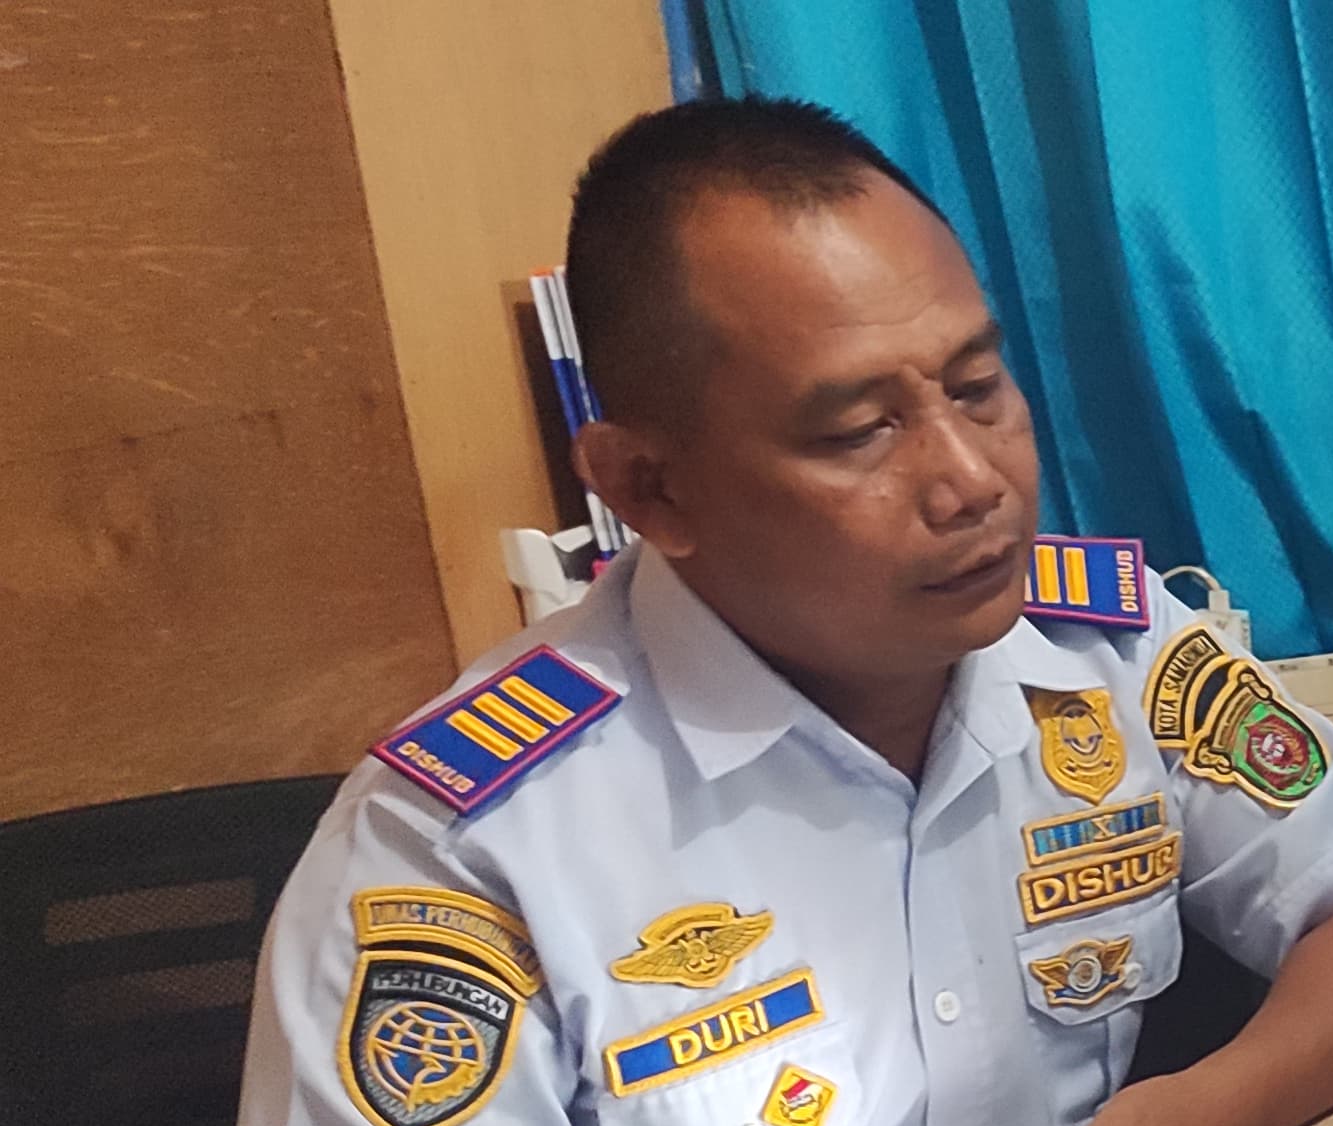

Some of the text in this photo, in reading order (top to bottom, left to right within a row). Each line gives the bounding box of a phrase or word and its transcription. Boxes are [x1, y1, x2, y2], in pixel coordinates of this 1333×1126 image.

[1116, 550, 1140, 612] DISHUB
[1159, 699, 1178, 733] KOTA
[397, 741, 476, 793] DISHUB
[1032, 845, 1174, 910] DISHUB
[668, 999, 770, 1066] DURI
